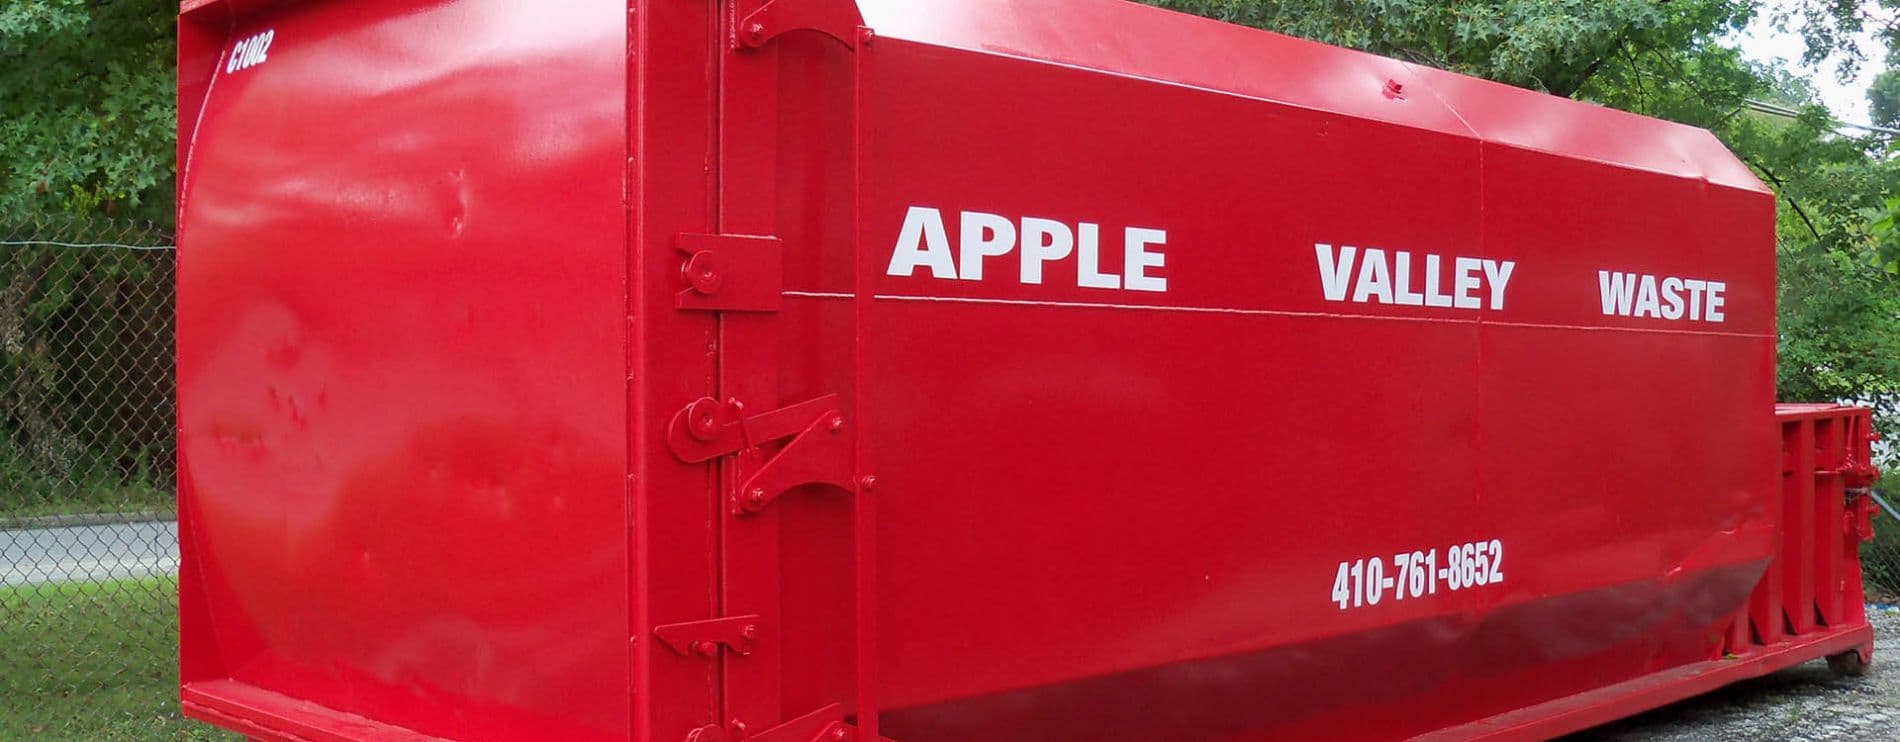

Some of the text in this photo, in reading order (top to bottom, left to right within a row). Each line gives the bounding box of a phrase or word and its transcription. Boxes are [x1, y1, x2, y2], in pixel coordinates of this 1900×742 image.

[226, 29, 275, 74] C1002
[887, 206, 1726, 322] APPLE VALLEY WASTE
[1332, 539, 1504, 610] 410-761-8652
